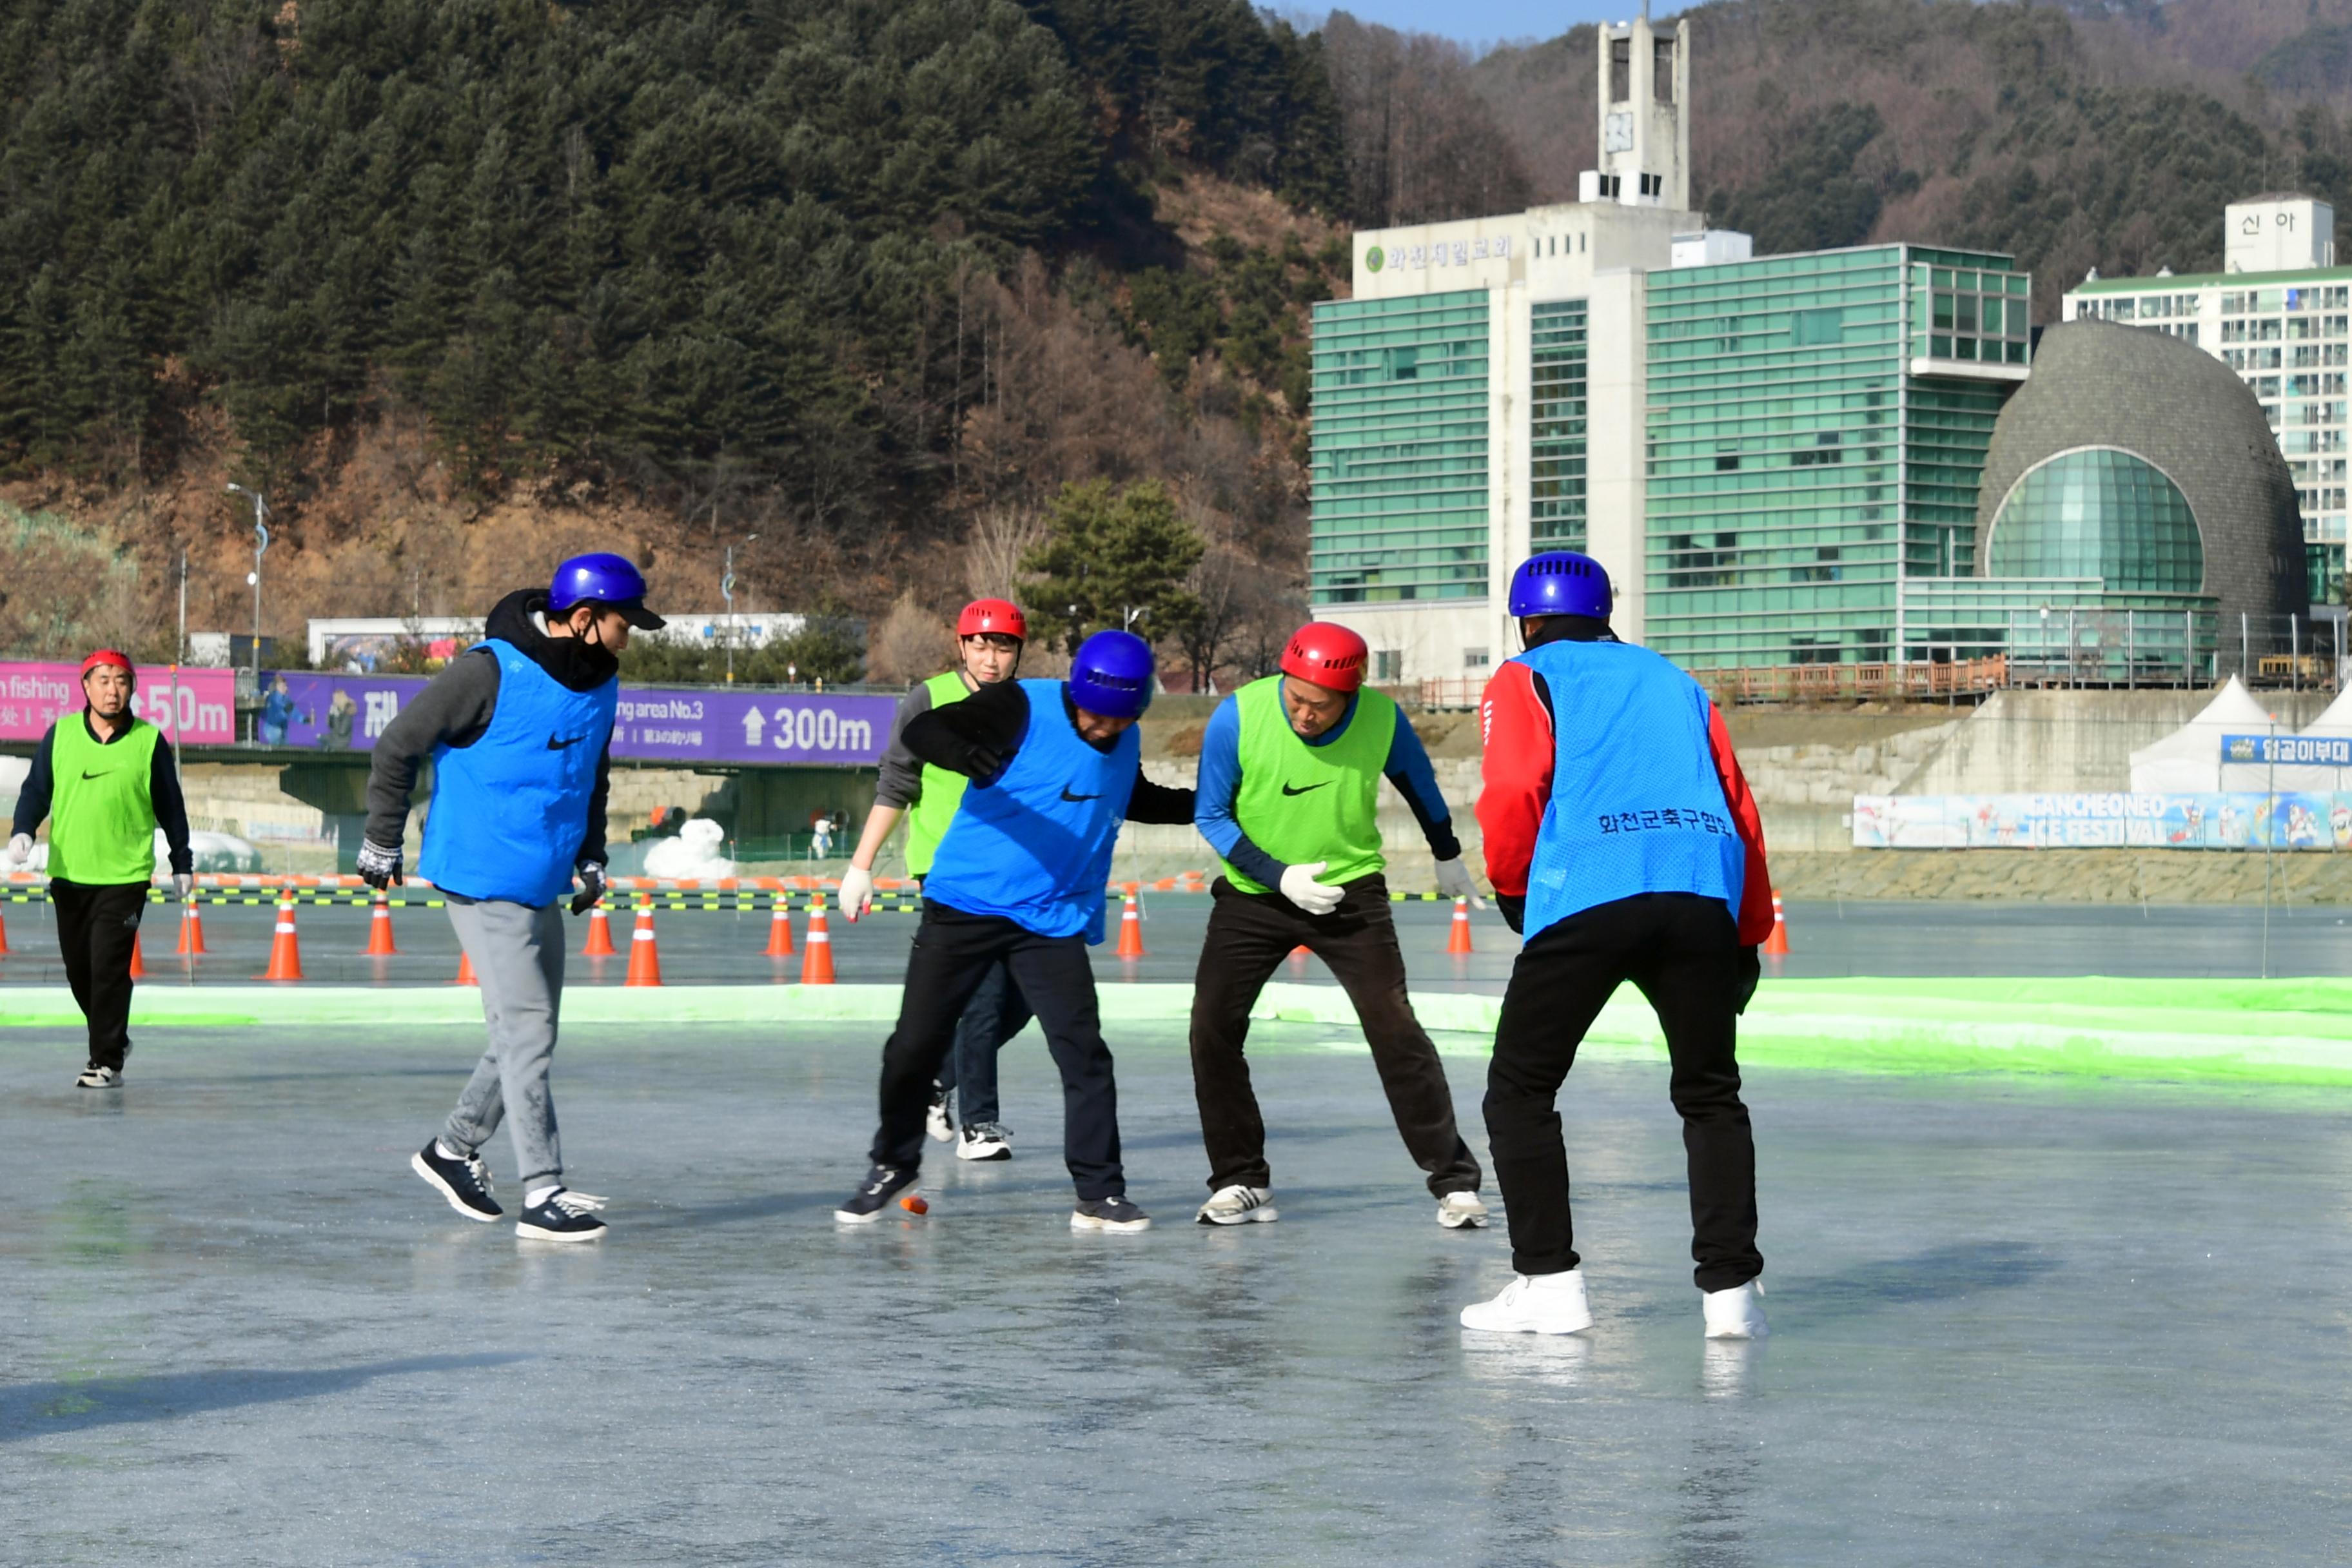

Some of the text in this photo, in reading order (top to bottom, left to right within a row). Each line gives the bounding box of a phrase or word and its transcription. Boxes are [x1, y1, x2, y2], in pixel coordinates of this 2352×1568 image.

[1387, 235, 1511, 271] 화천제일교회
[10, 675, 70, 705] fishing
[148, 685, 228, 732] 50m
[636, 703, 667, 718] area
[669, 700, 703, 720] No.3
[774, 707, 871, 750] 300m
[2067, 819, 2167, 844] FESTIVAL
